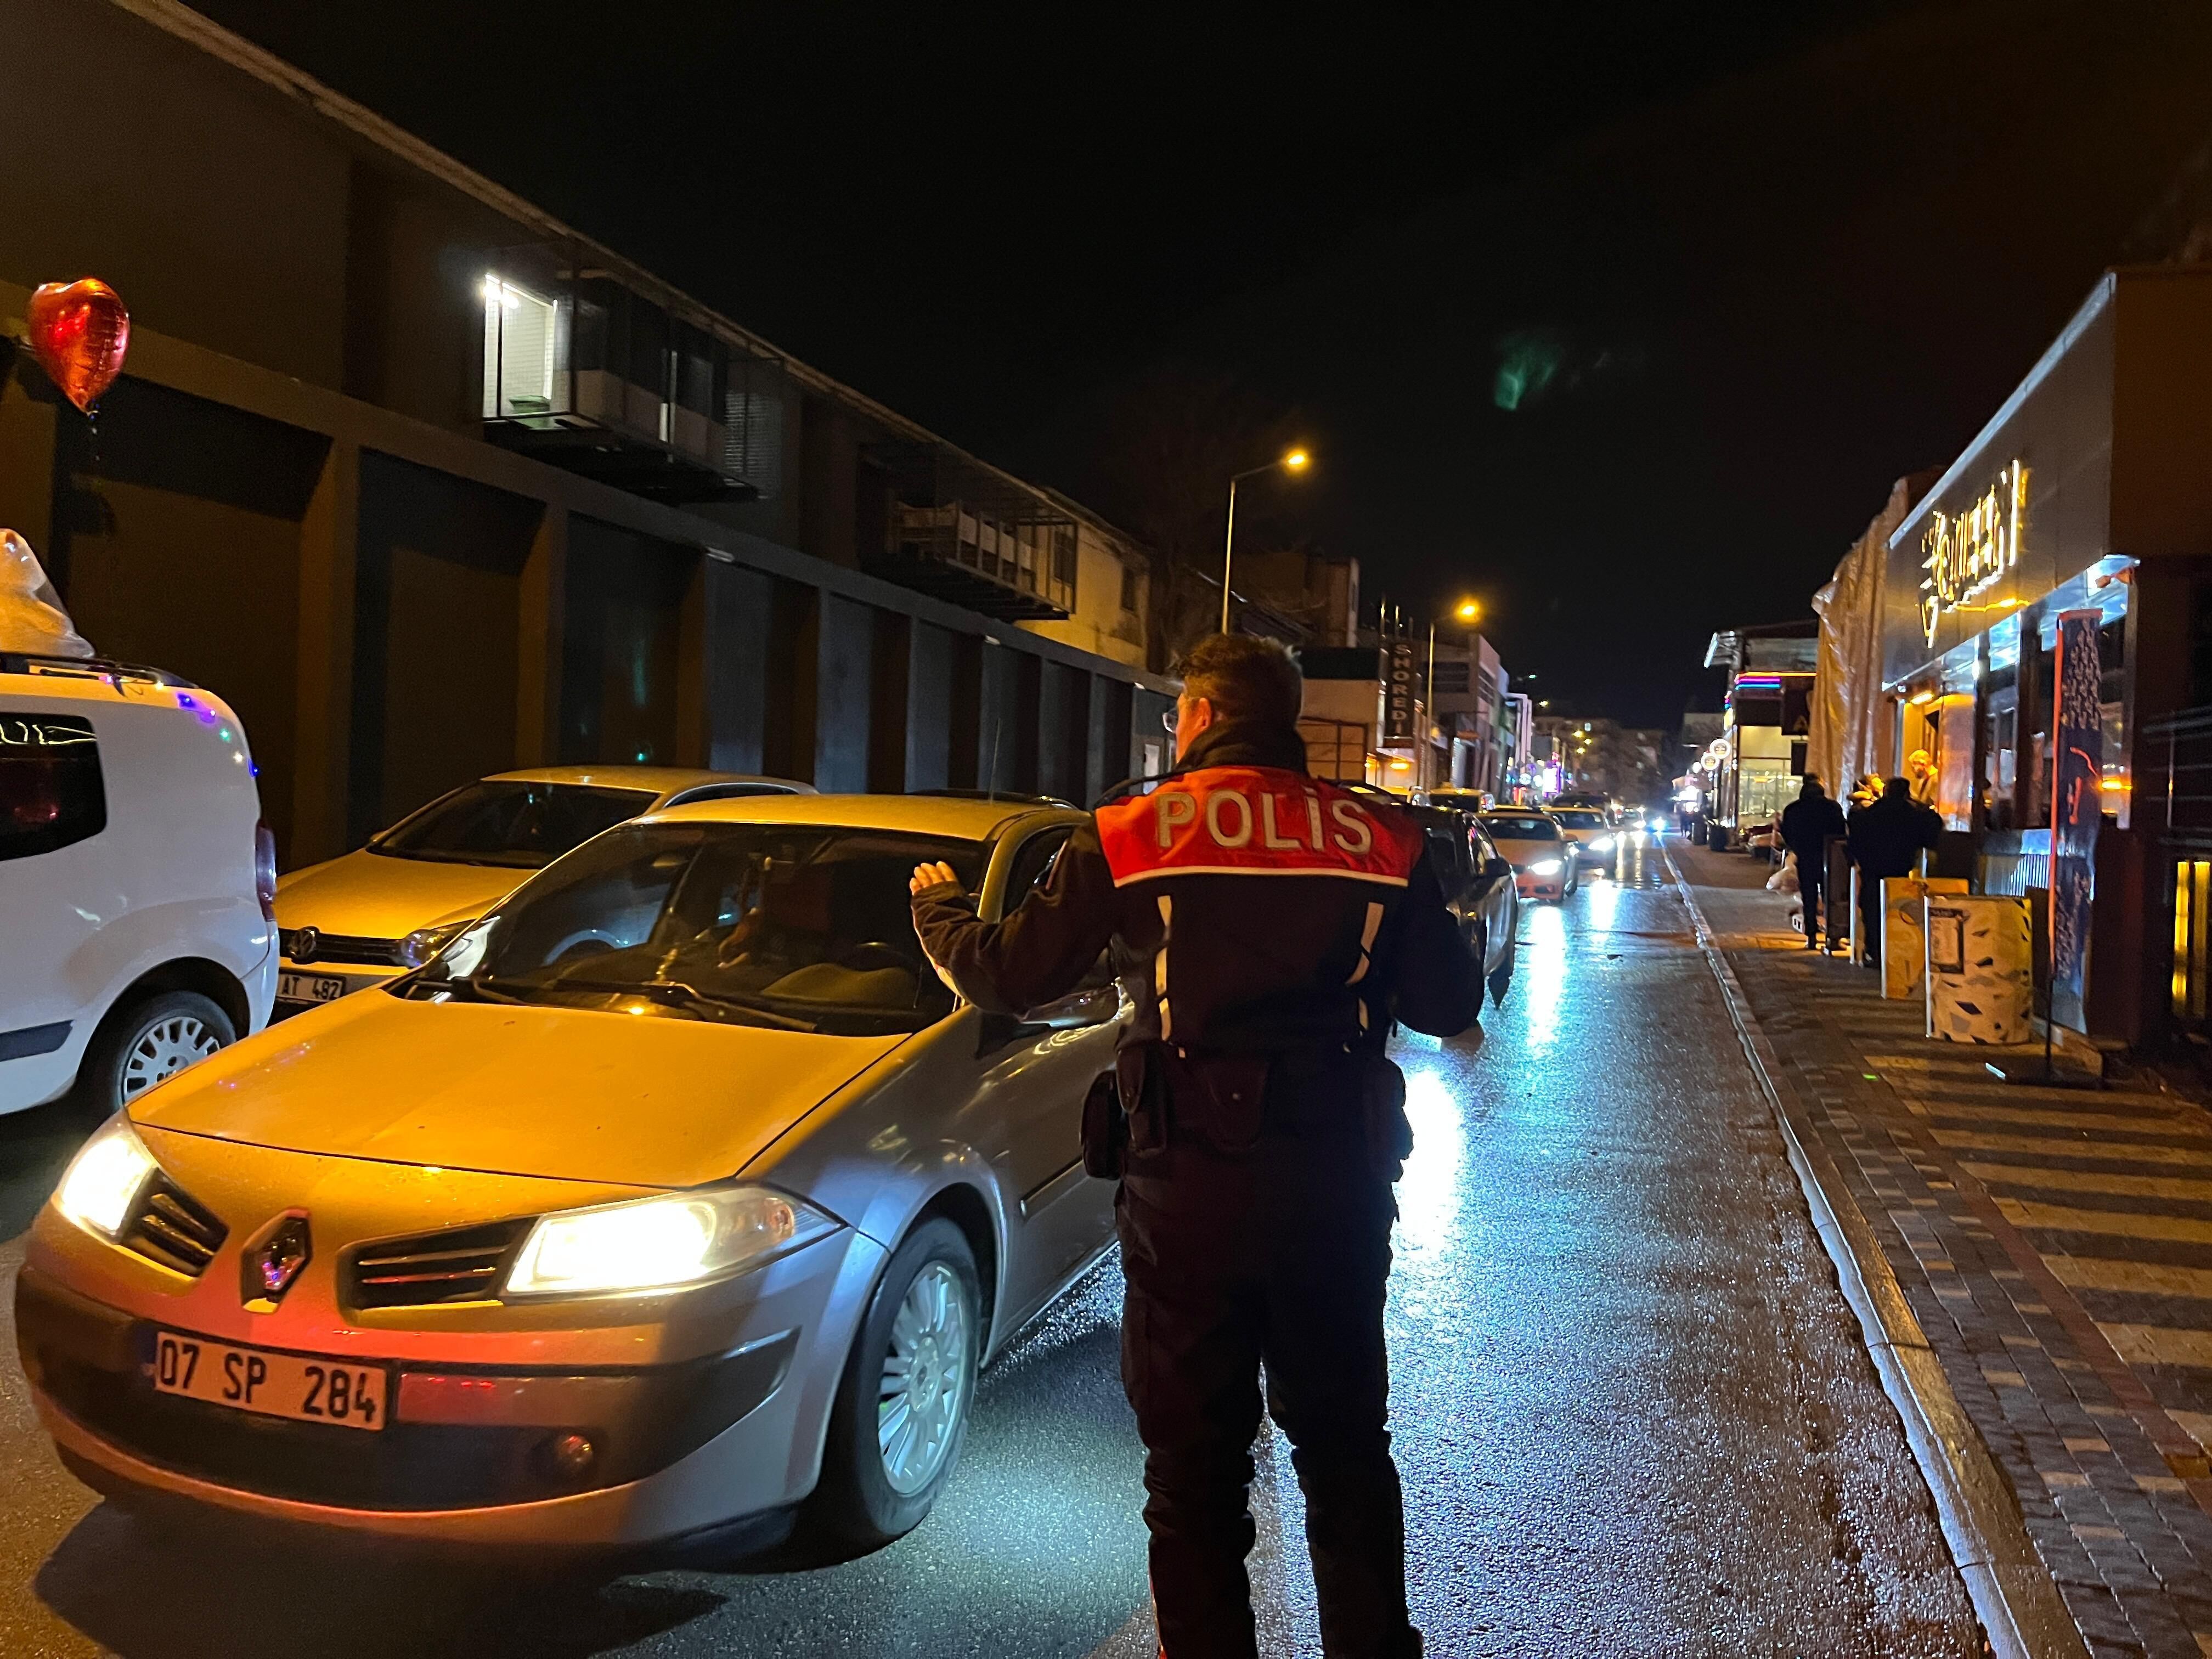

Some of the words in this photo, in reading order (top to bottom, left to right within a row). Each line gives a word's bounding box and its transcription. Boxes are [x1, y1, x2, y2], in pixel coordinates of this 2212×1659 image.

[1156, 786, 1372, 855] POLİS
[161, 1339, 200, 1390] 07
[222, 1352, 267, 1403] SP
[302, 1366, 376, 1423] 284
